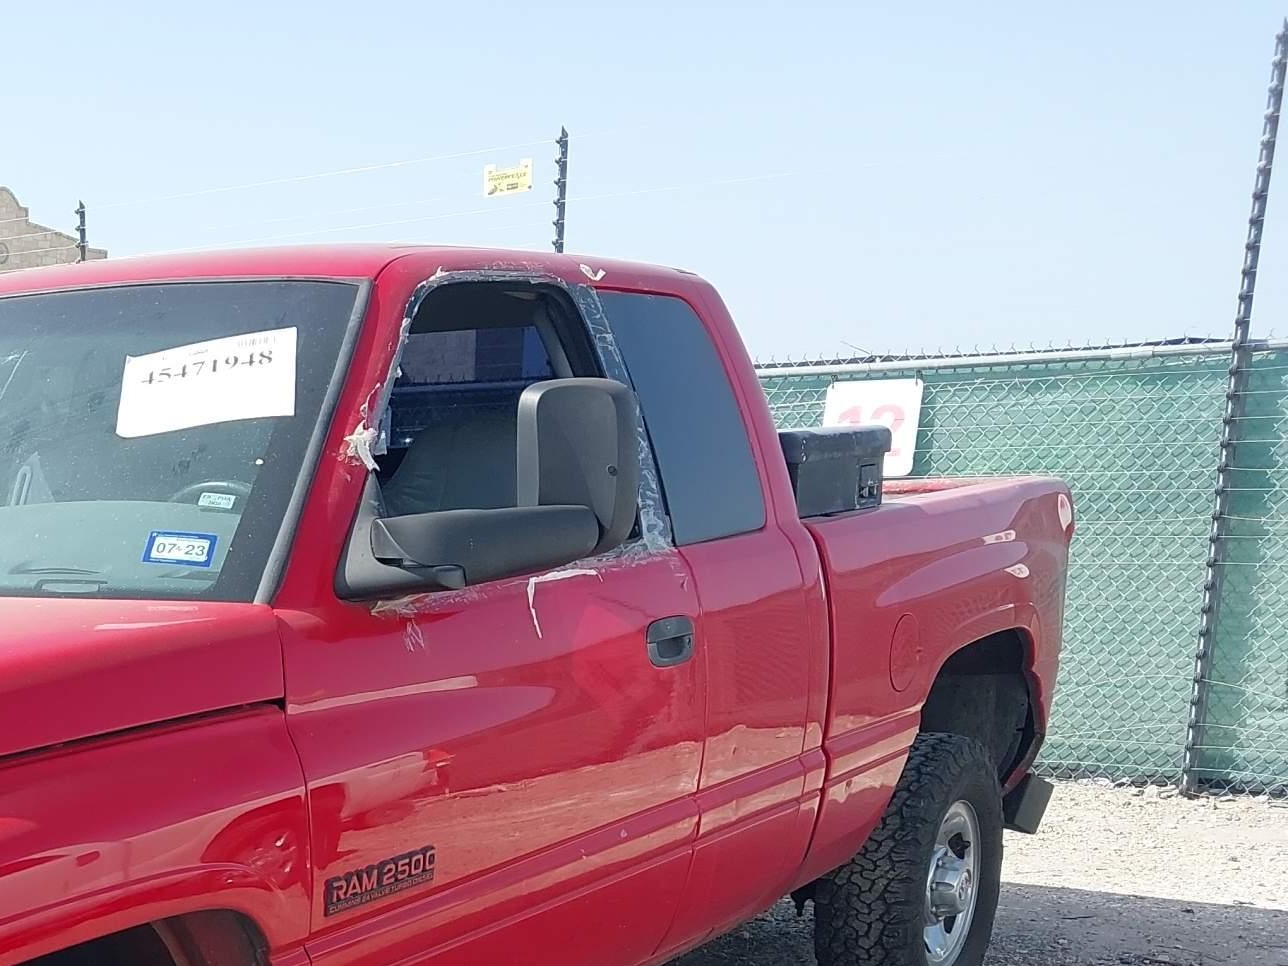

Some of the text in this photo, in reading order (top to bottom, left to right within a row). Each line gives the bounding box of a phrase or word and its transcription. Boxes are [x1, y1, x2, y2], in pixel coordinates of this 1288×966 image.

[141, 350, 273, 385] 45471948
[156, 542, 206, 557] 07 23
[332, 850, 435, 904] RAM 2500
